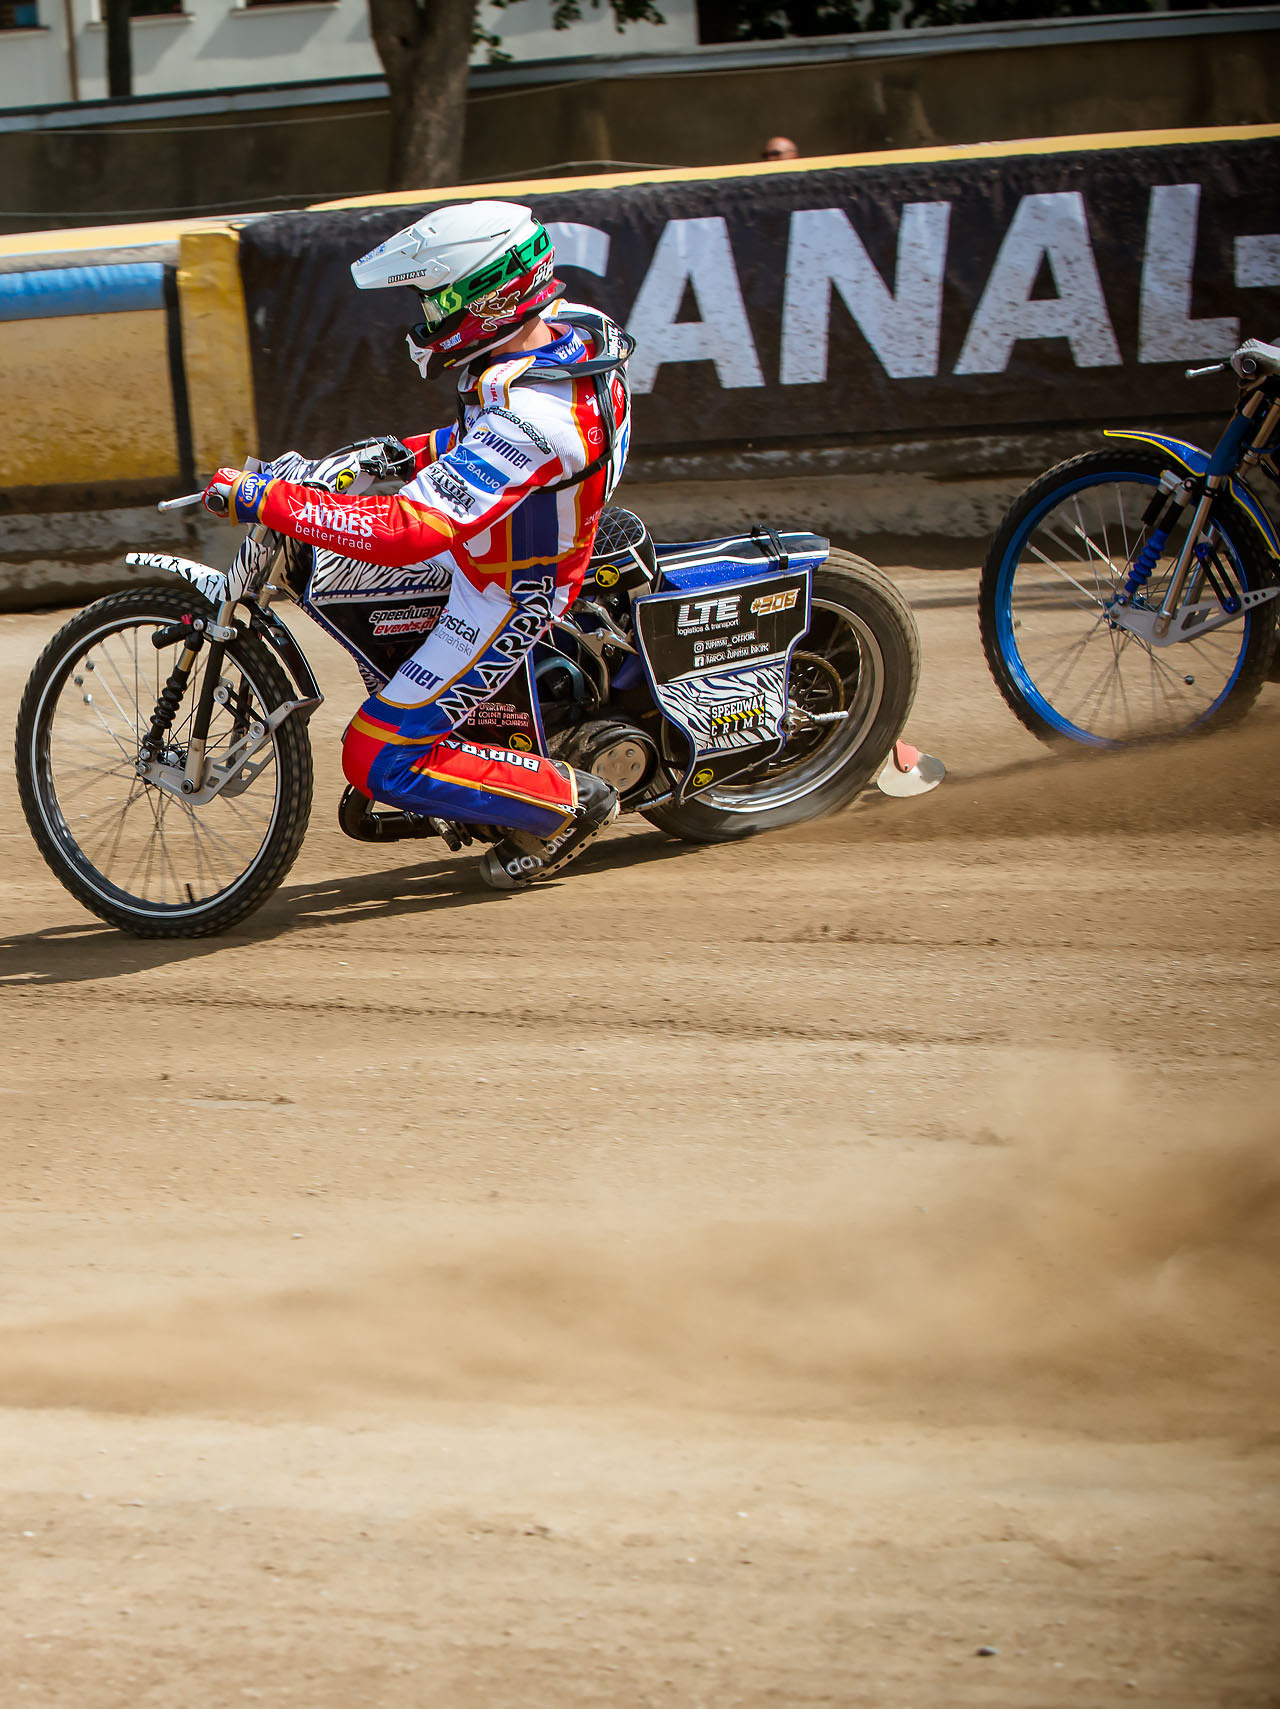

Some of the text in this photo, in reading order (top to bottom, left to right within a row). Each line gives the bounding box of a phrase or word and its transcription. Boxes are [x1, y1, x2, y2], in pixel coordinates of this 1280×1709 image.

[467, 462, 500, 489] BALUO
[297, 501, 375, 537] AVIDES
[295, 522, 372, 551] better trade
[369, 605, 441, 624] speedway
[677, 596, 742, 627] LTE
[677, 625, 704, 637] logistics
[711, 619, 739, 632] transport
[711, 695, 765, 719] SPEEDWAY
[712, 714, 765, 736] CRIME
